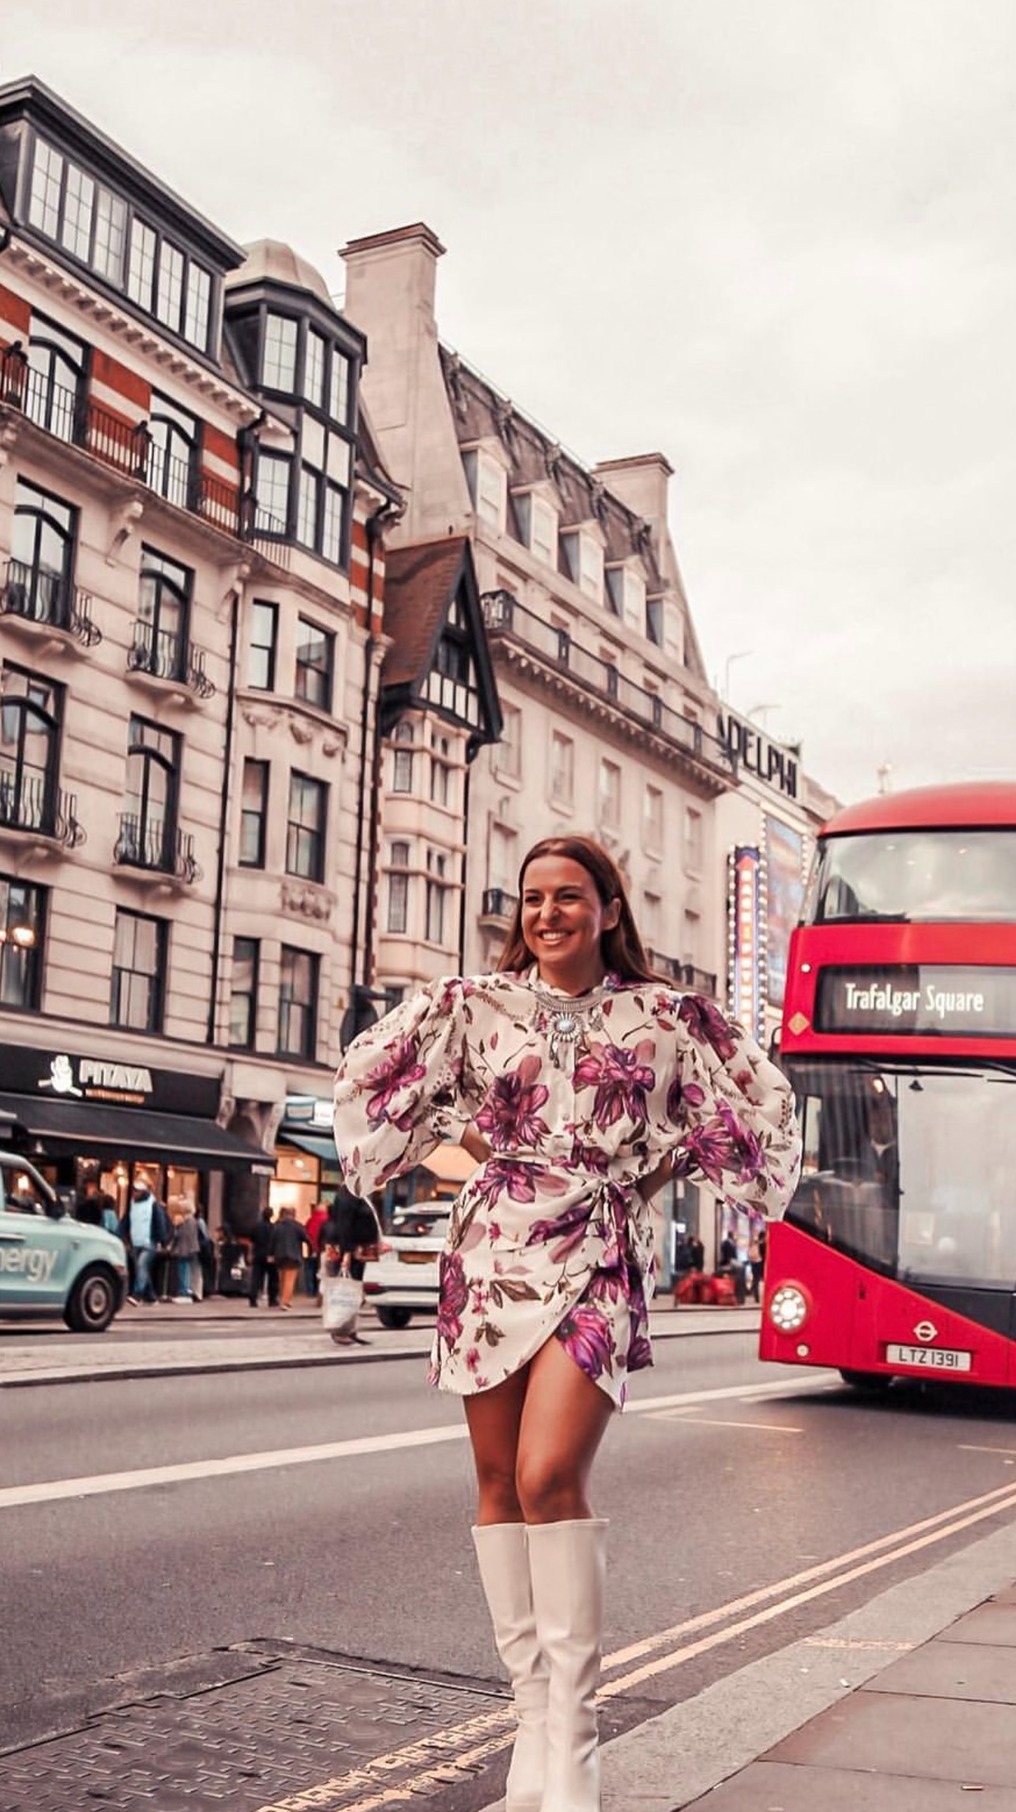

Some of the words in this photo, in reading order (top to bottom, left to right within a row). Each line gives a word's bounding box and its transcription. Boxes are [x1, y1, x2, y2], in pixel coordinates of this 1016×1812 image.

[845, 983, 921, 1016] Trafalgar
[925, 985, 984, 1018] Square
[80, 1059, 153, 1093] PITAYA
